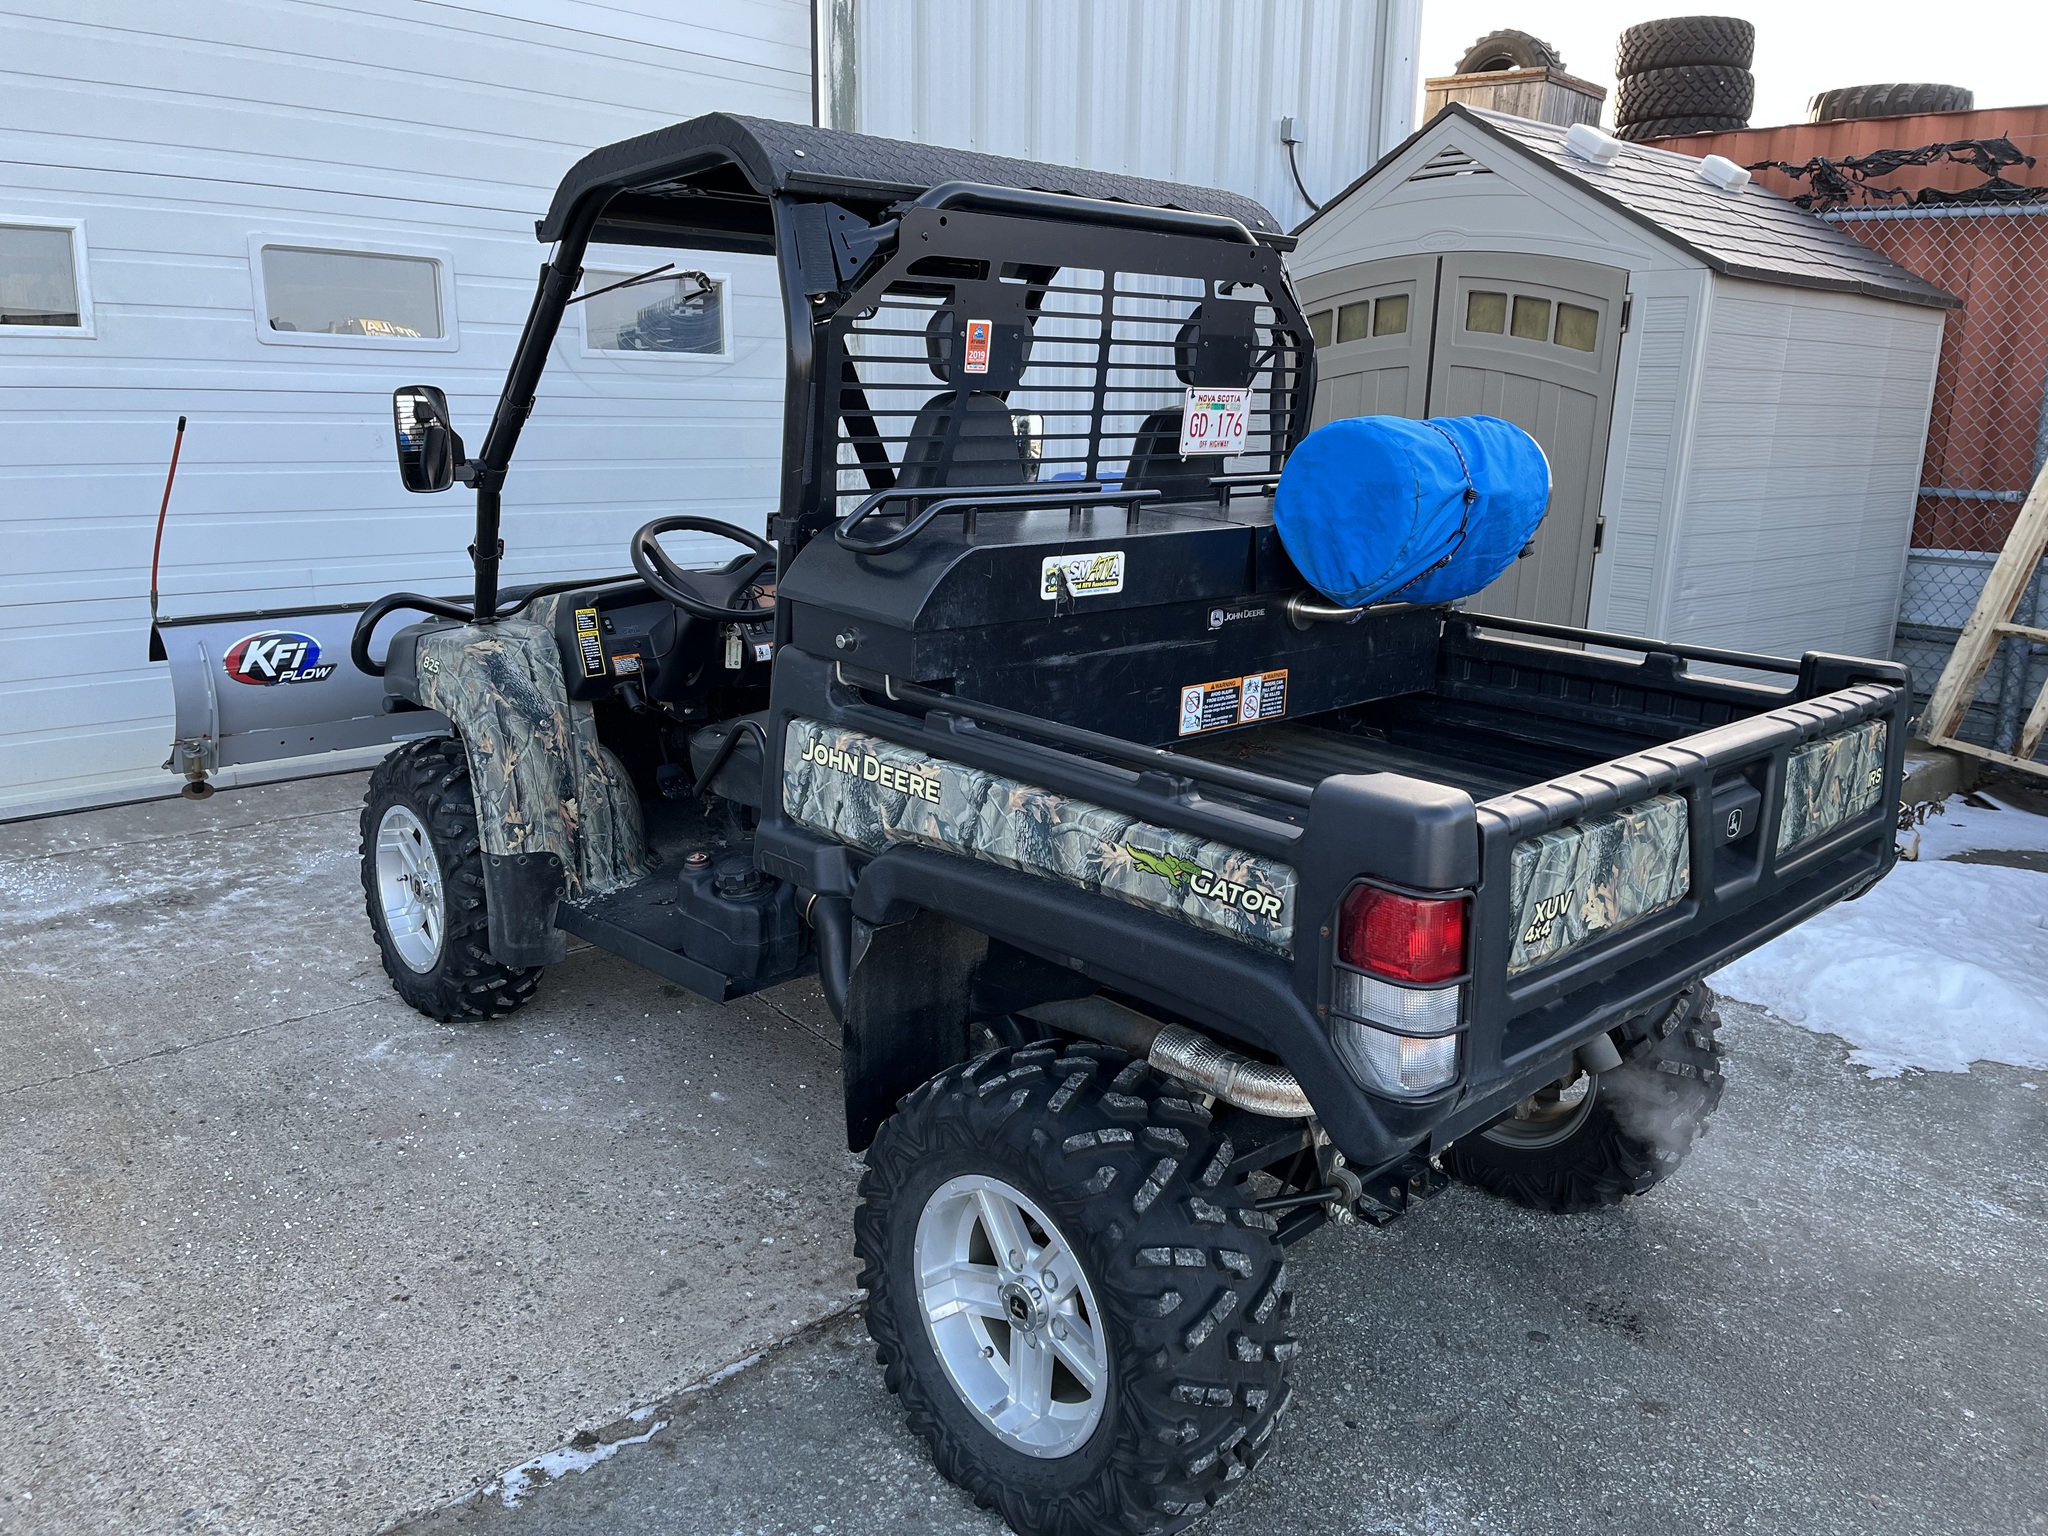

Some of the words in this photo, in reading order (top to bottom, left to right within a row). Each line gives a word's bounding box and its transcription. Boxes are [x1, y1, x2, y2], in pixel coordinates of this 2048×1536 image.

[969, 350, 985, 359] 2019
[1209, 440, 1229, 448] HIGHWAY
[1224, 612, 1243, 621] JOHN
[1244, 608, 1265, 618] DEERE
[239, 639, 308, 677] KFi
[278, 667, 332, 682] PLOW
[1216, 681, 1236, 689] WARNING
[1217, 693, 1236, 701] EXPLOSION
[801, 736, 859, 777] JOHN
[862, 754, 941, 805] DEERE
[1867, 767, 1883, 789] IRS
[1190, 869, 1283, 922] GATOR
[1532, 889, 1575, 925] XUV
[1523, 920, 1552, 944] 4x4
